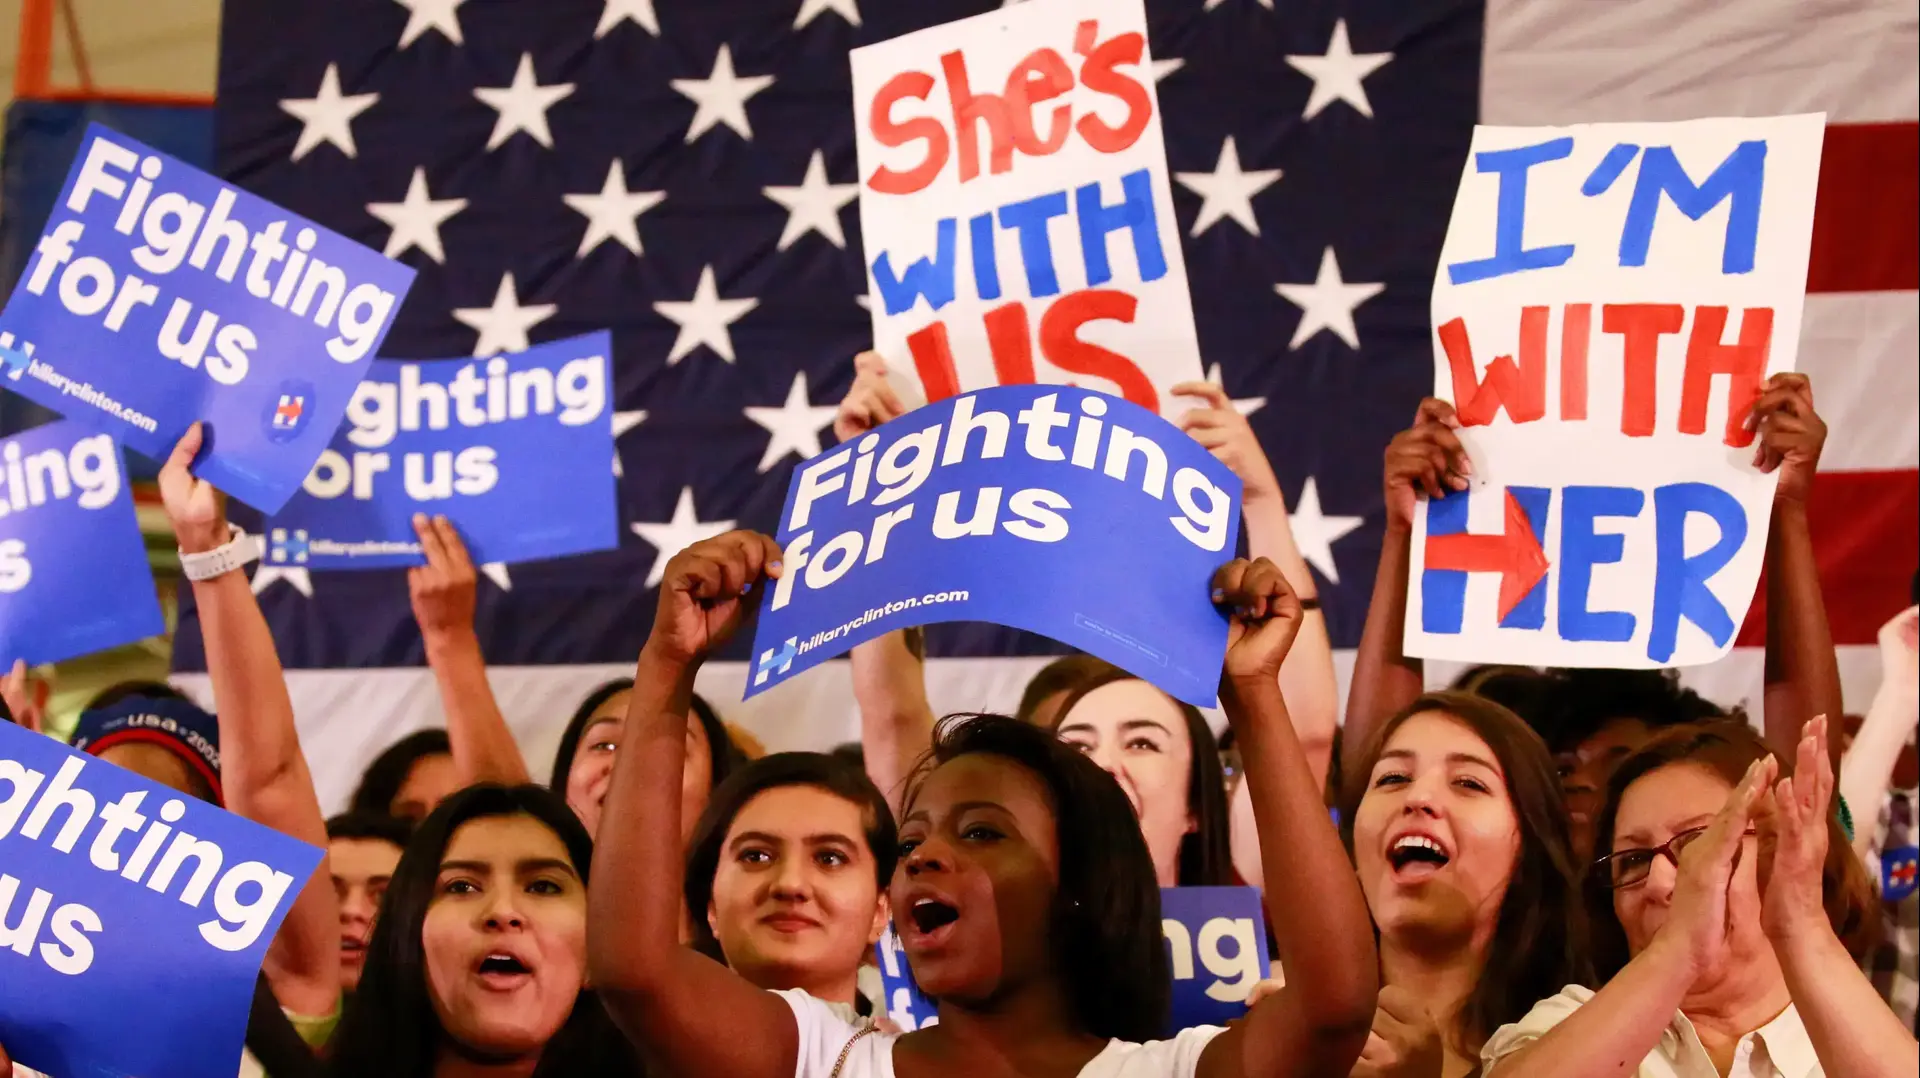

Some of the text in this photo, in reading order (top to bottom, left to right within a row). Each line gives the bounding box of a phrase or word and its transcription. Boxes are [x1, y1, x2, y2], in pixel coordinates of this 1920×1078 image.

[866, 19, 1152, 195] She's
[66, 137, 396, 364] Fighting
[870, 168, 1168, 316] WITH
[1447, 136, 1768, 286] I'M
[26, 220, 258, 386] for us
[906, 289, 1160, 415] US
[27, 358, 158, 433] hillaryclinton.com
[346, 356, 606, 448] ghting
[1437, 303, 1775, 448] WITH
[0, 433, 120, 520] ing
[302, 449, 391, 499] or
[404, 446, 499, 501] us
[788, 391, 1232, 552] Fighting
[767, 486, 1073, 612] for us
[1421, 482, 1748, 664] HER
[798, 590, 969, 655] hillaryclinton.com
[127, 713, 178, 732] usa
[0, 873, 103, 975] us
